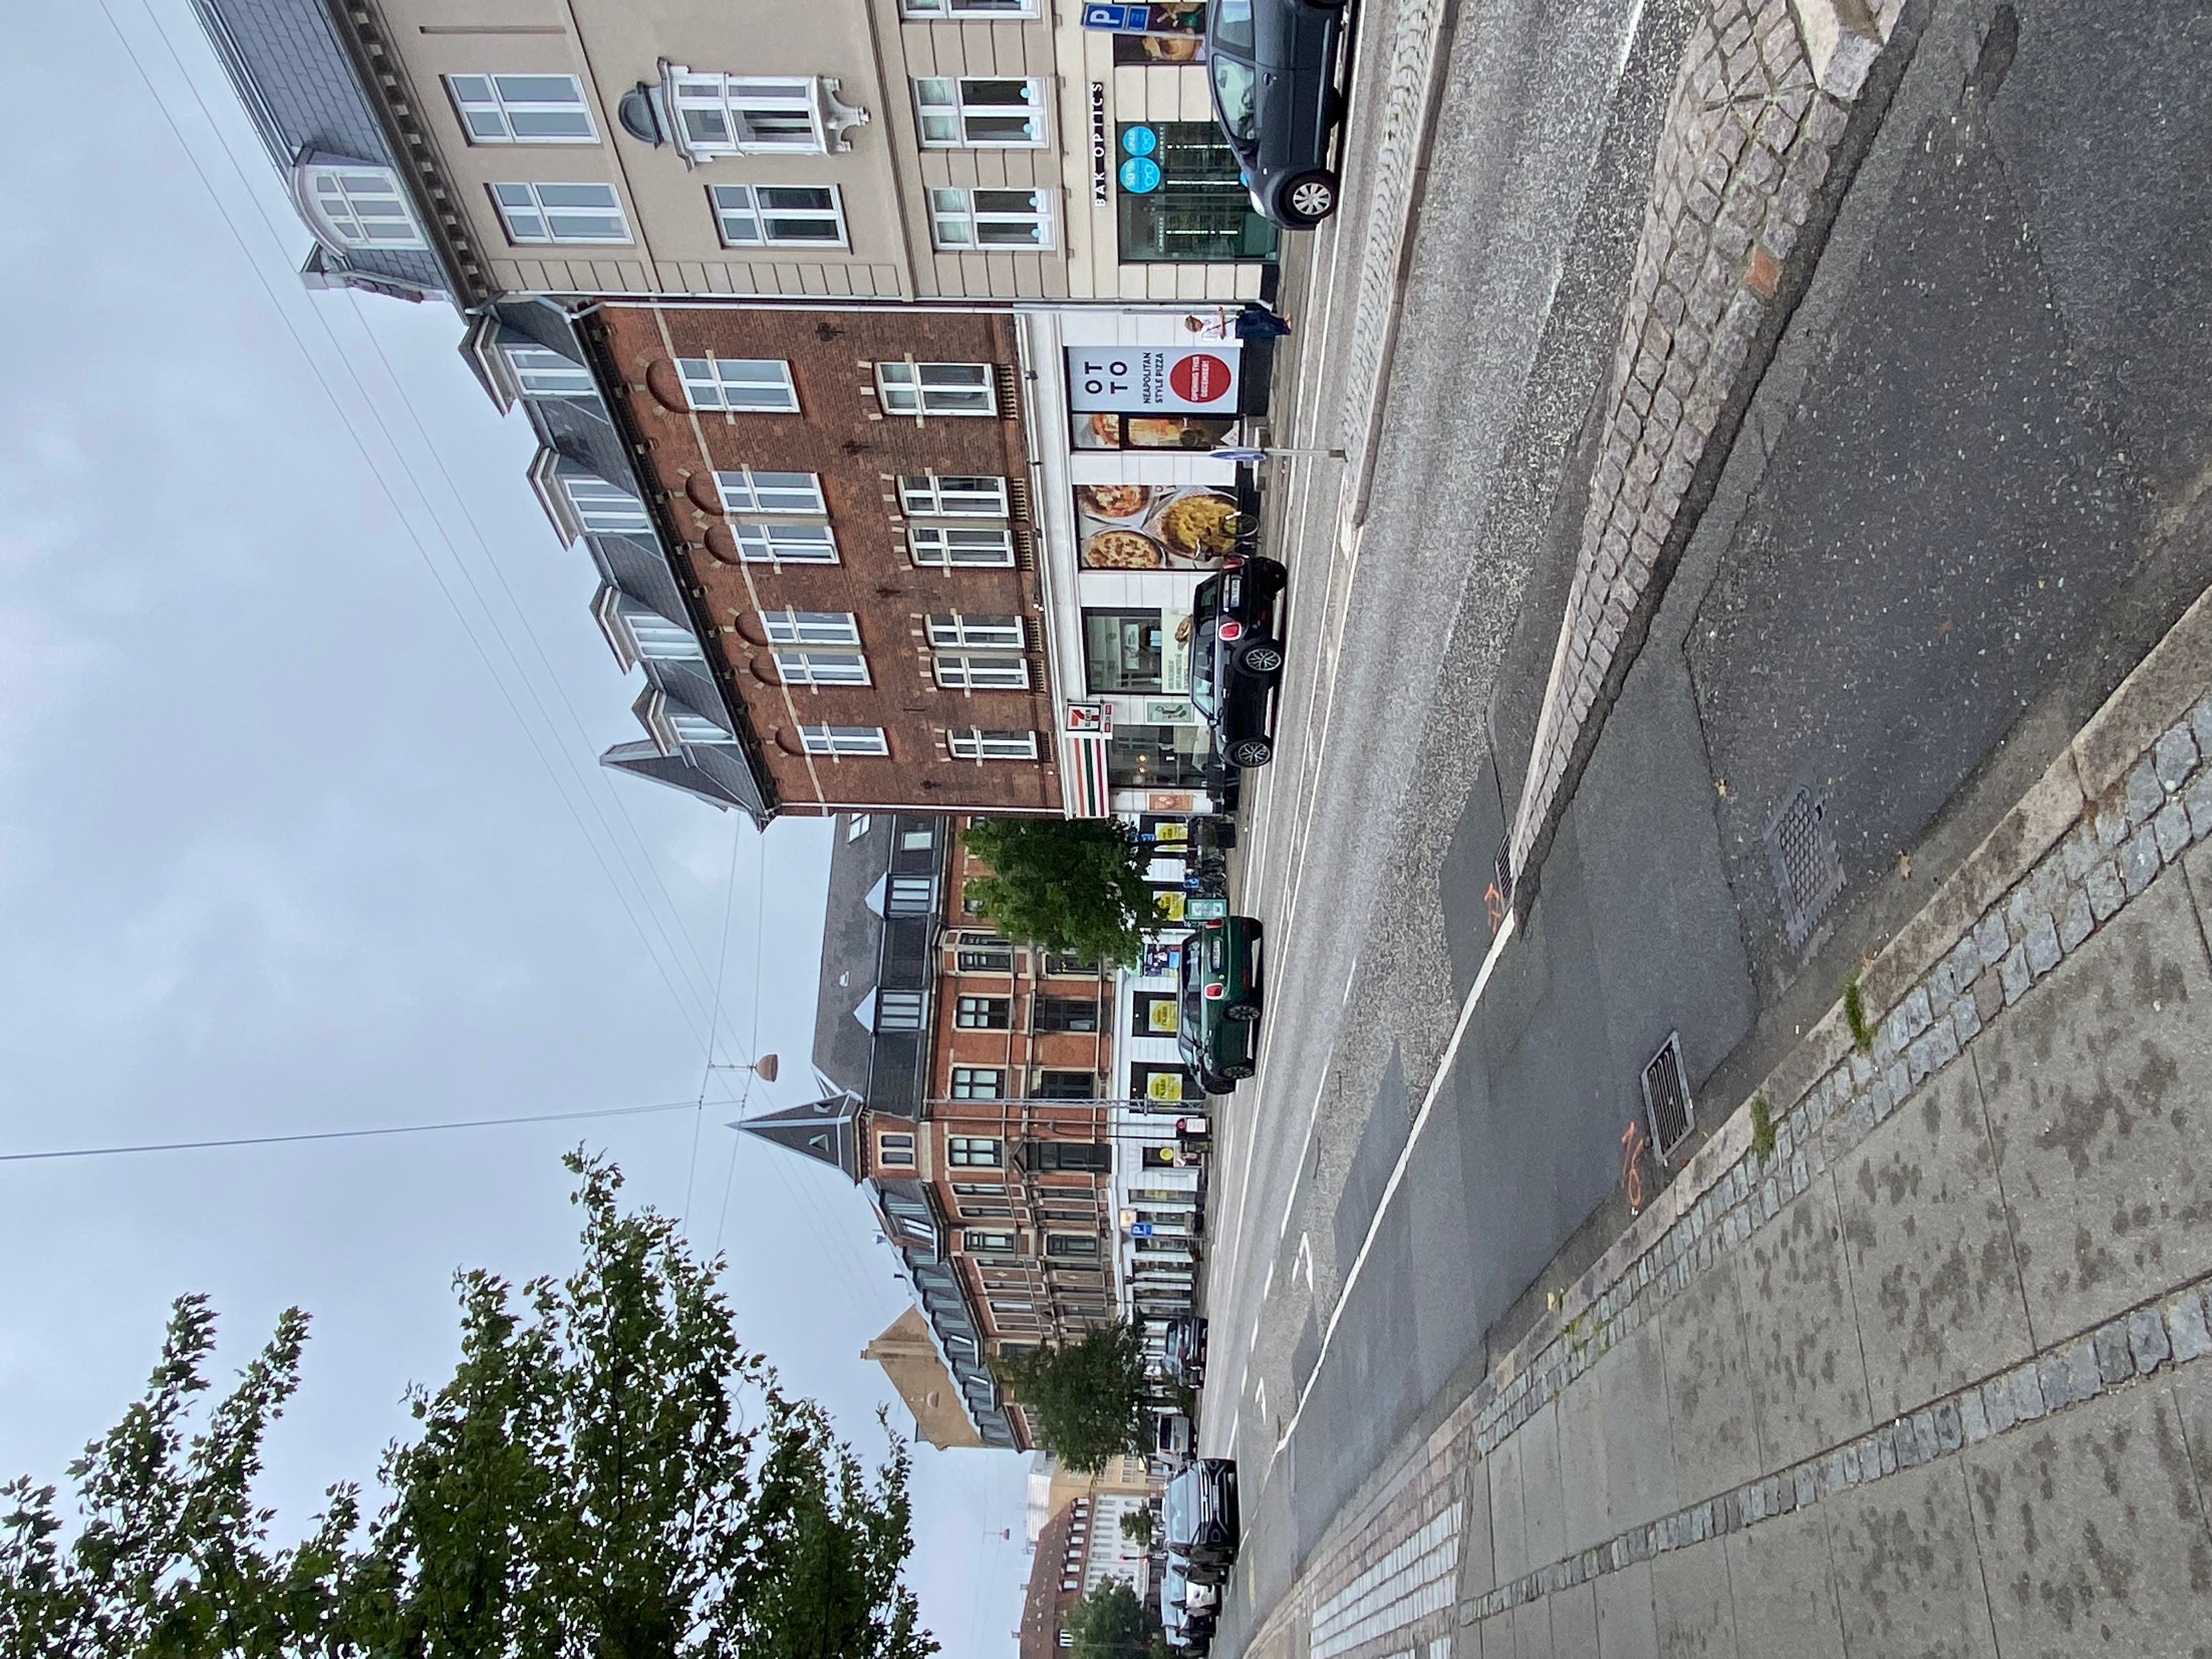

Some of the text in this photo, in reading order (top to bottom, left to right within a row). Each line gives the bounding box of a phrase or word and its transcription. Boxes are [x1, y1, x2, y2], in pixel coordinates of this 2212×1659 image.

[1090, 10, 1120, 24] P
[1090, 83, 1106, 207] BAK OPTICS
[1143, 352, 1151, 403] NEAPOLITAN
[1155, 353, 1163, 403] STYLE PIZZA
